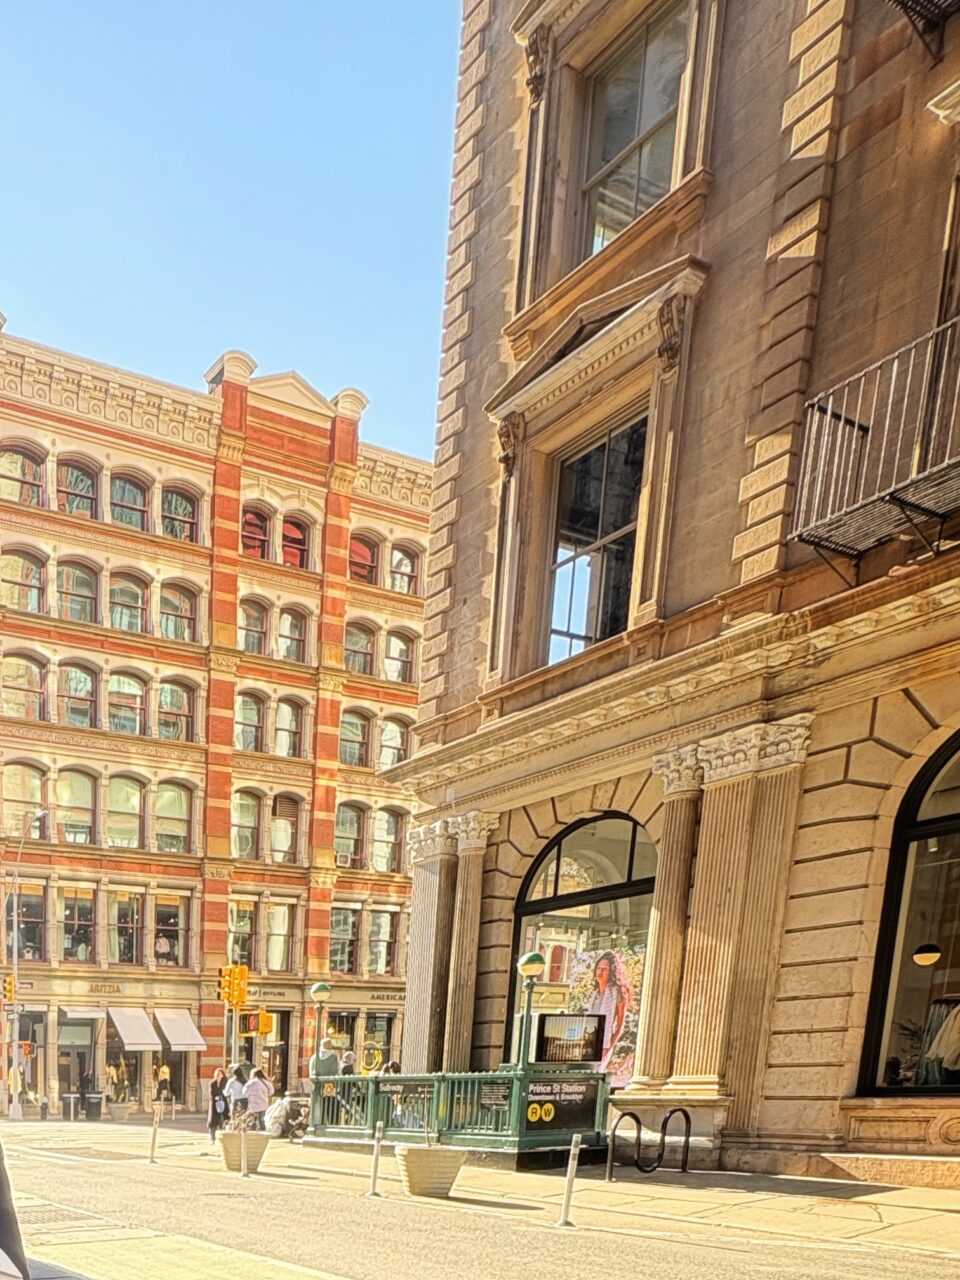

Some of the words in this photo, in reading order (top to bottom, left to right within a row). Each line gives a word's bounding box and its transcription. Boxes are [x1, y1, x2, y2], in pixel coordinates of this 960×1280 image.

[379, 1083, 404, 1093] Subway
[528, 1084, 551, 1093] Prince
[553, 1084, 560, 1093] St
[562, 1084, 586, 1093] Station
[531, 1107, 538, 1117] R
[543, 1107, 552, 1117] W
